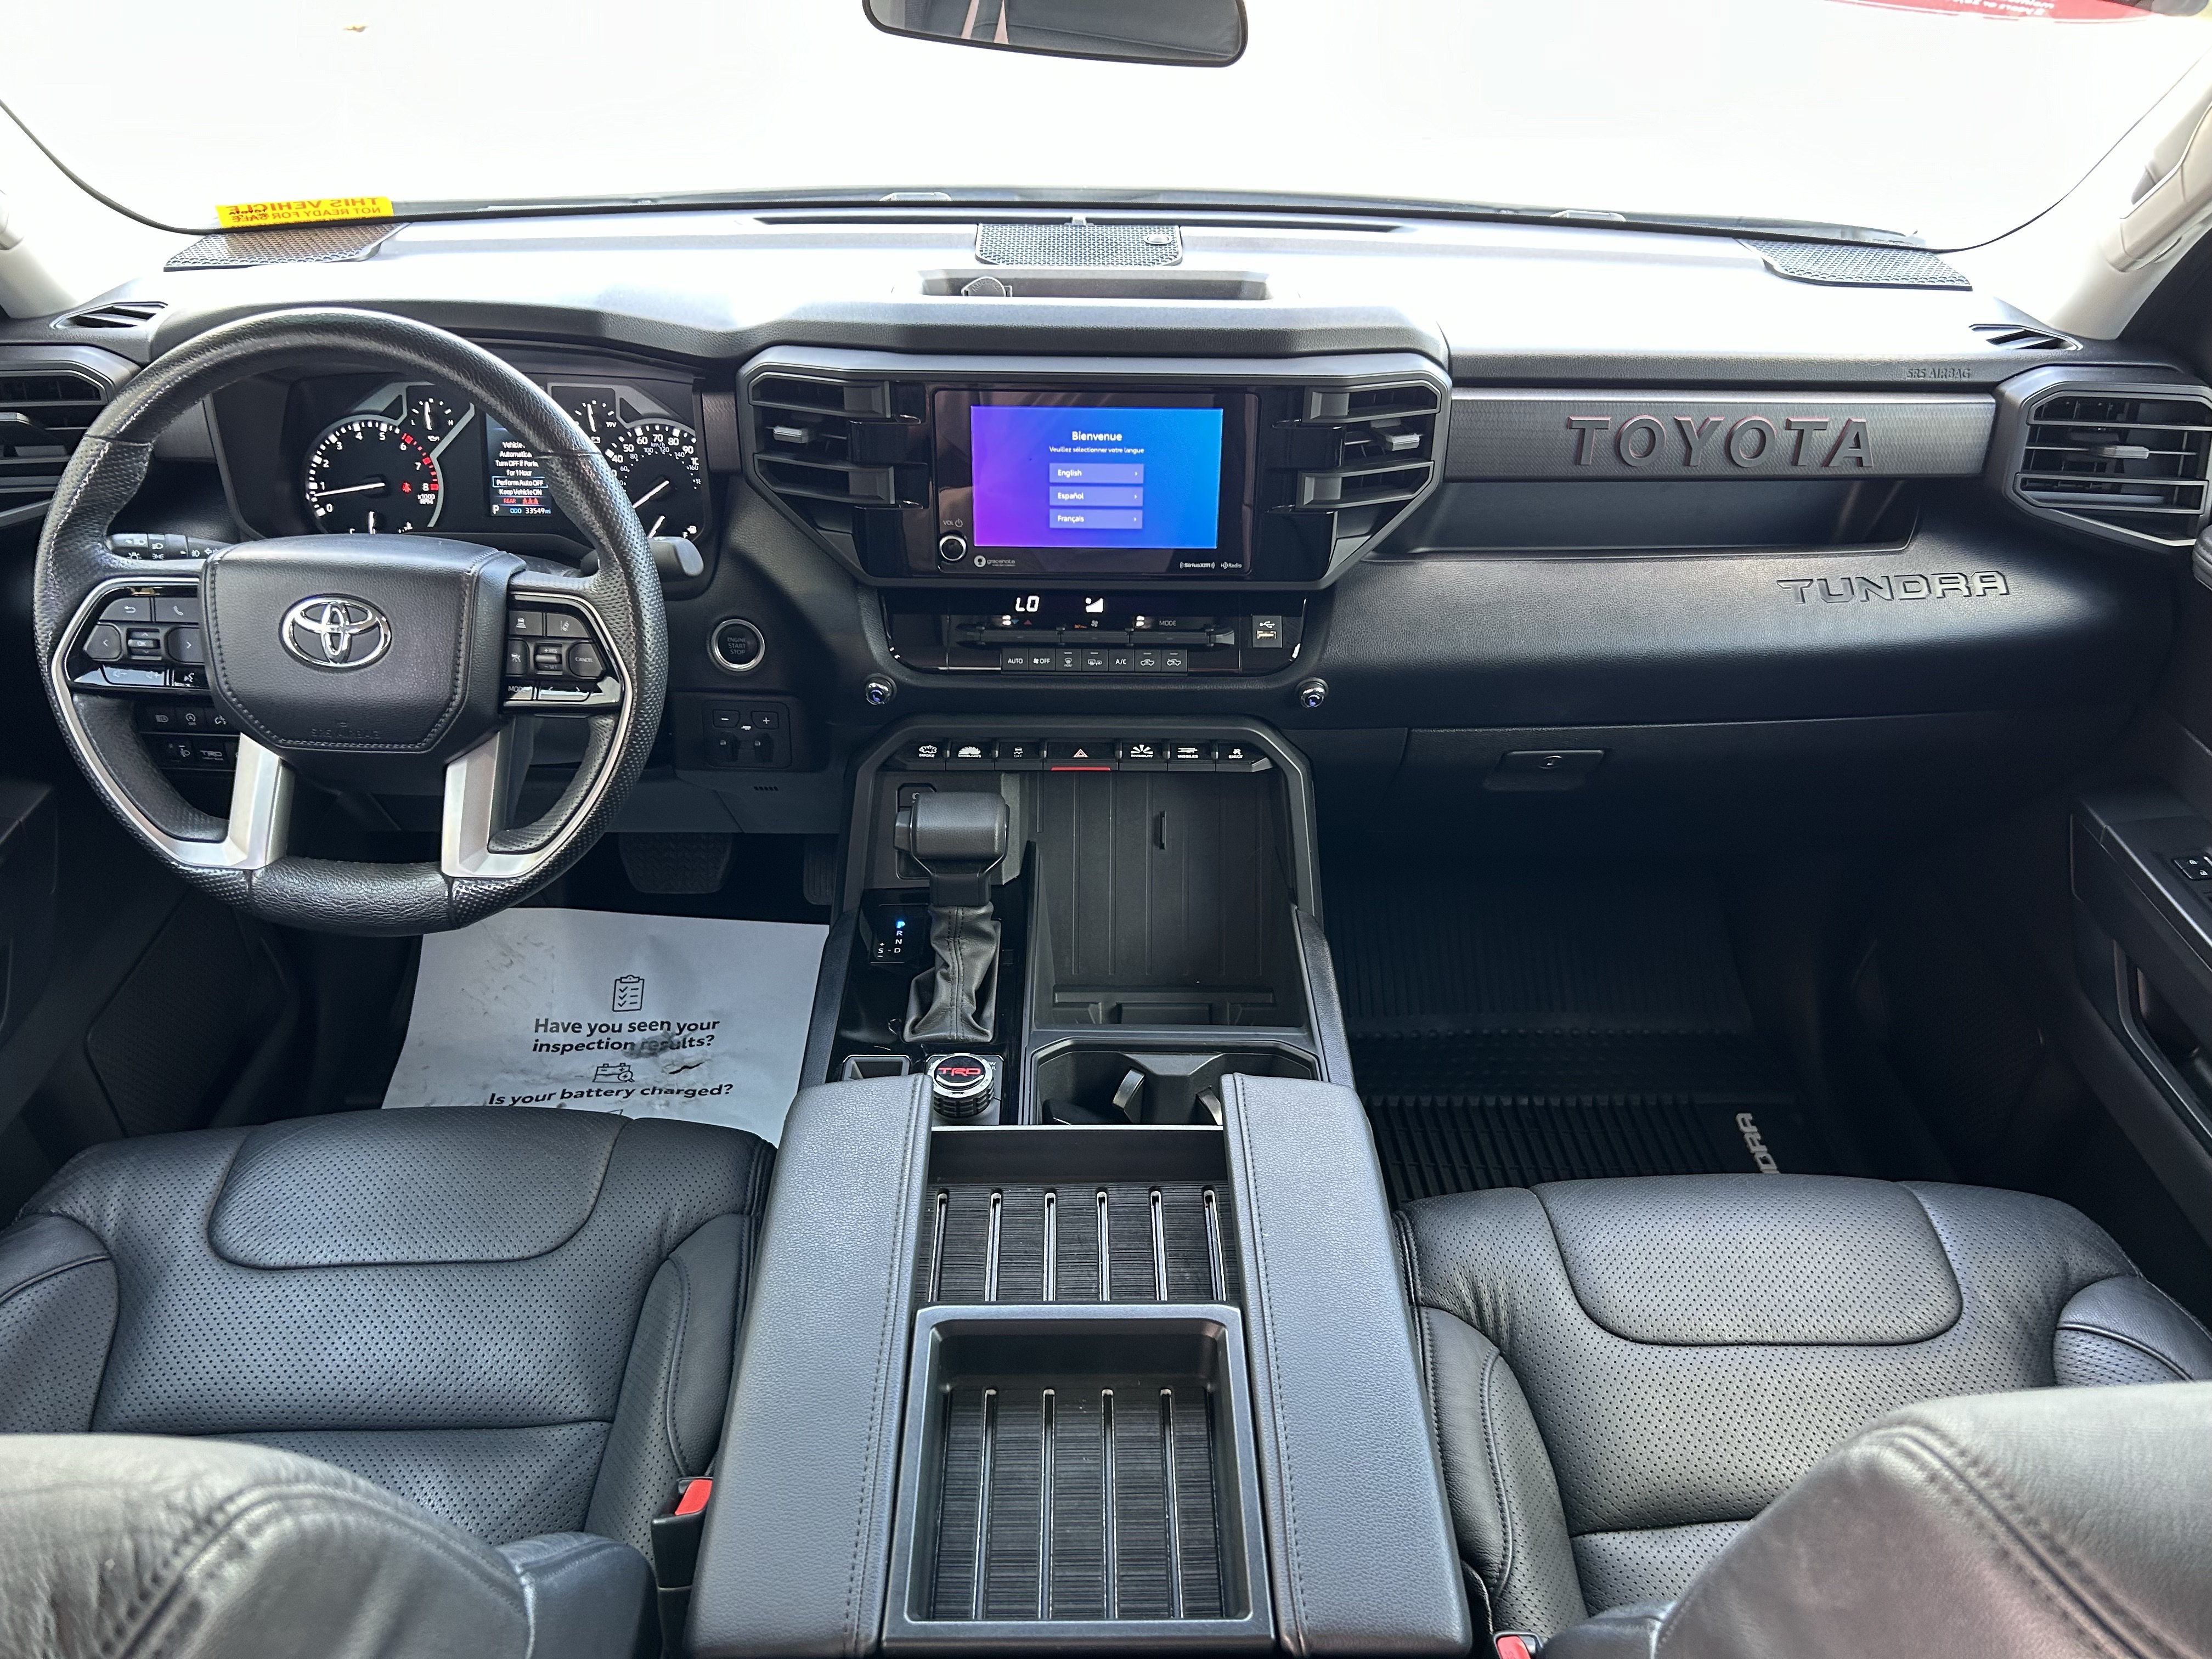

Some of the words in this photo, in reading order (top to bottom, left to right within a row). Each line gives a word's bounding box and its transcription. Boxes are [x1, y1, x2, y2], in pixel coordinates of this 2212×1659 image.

[1906, 368, 1926, 379] SRS
[1929, 368, 1971, 379] AIRBAG
[355, 432, 363, 441] 4
[379, 432, 386, 441] 5
[652, 434, 663, 442] 70
[1071, 431, 1122, 441] Bienvenue
[668, 437, 679, 445] 80
[1566, 414, 1875, 469] TOYOTA
[336, 442, 343, 450] 3
[623, 444, 634, 452] 50
[682, 445, 693, 454] 90
[612, 455, 623, 463] 40
[323, 460, 330, 468] 2
[415, 462, 421, 471] 7
[1057, 469, 1082, 478] English
[422, 483, 429, 491] 8
[1057, 492, 1084, 500] Español
[326, 504, 334, 512] 0
[493, 505, 499, 514] P
[1057, 515, 1085, 523] Français
[1775, 571, 2010, 605] TUNDRA
[1015, 595, 1040, 612] LO
[896, 921, 906, 929] P
[534, 1018, 583, 1033] Have
[586, 1022, 623, 1037] you
[627, 1020, 672, 1032] seen
[675, 1019, 720, 1036] your
[532, 1037, 635, 1055] inspection
[640, 1034, 715, 1051] results?
[938, 1067, 981, 1077] TRD
[488, 1093, 506, 1104] Is
[509, 1092, 557, 1107] your
[560, 1087, 636, 1099] battery
[640, 1083, 734, 1099] charged?
